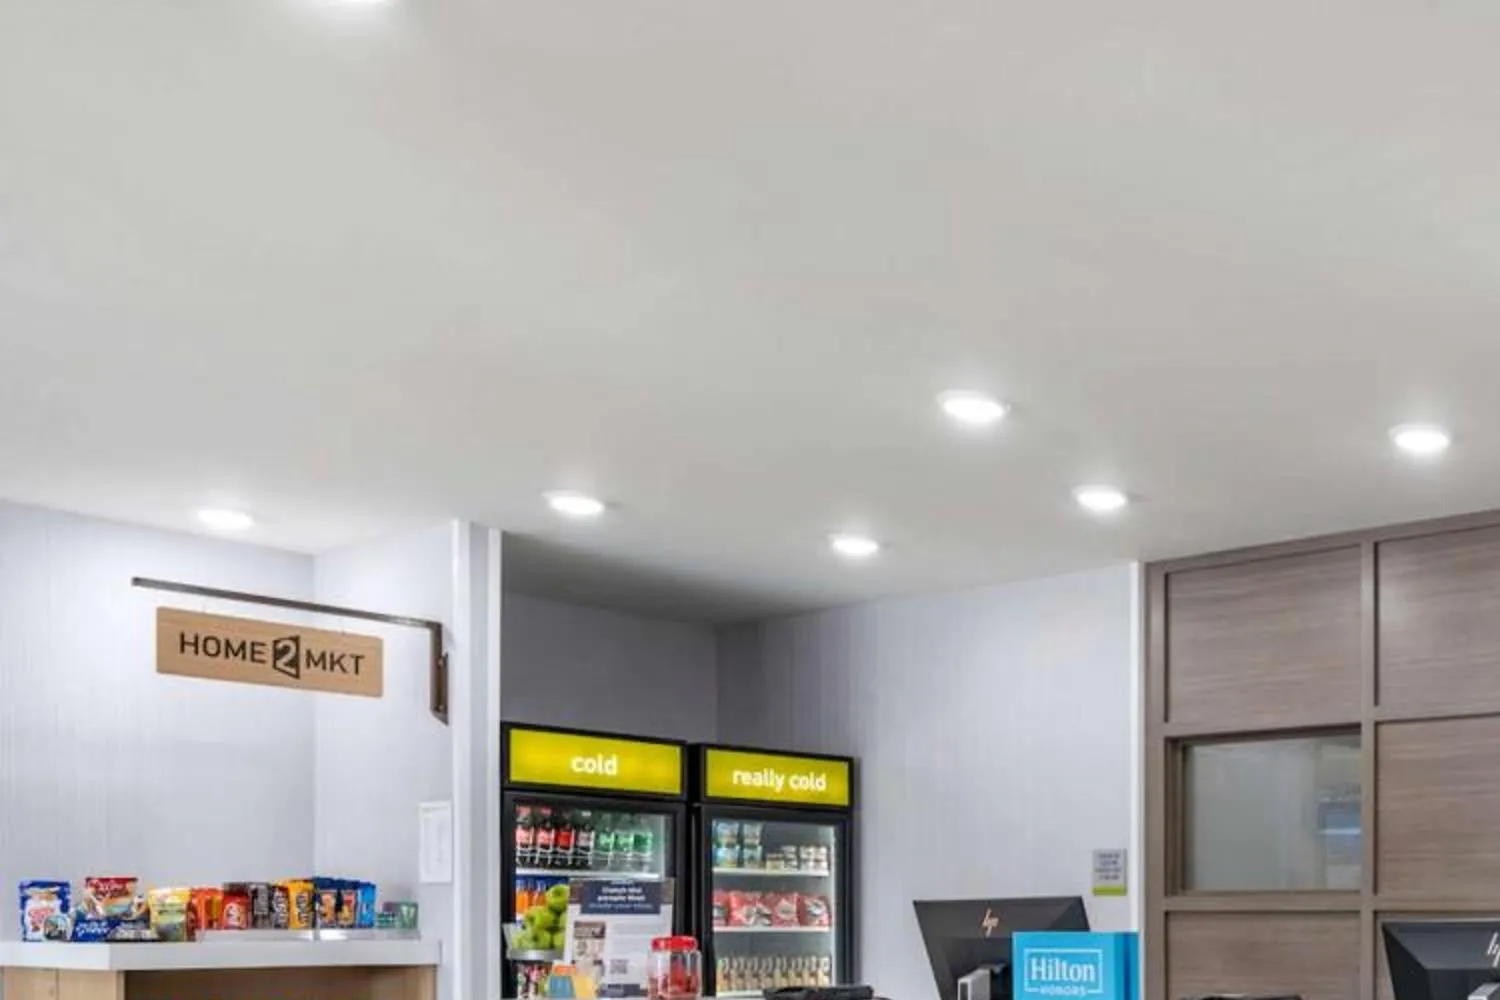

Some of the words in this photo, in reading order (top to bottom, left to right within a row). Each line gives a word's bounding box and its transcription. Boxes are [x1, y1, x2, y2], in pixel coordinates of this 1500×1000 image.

[179, 631, 267, 664] HOME
[274, 637, 299, 677] 2
[305, 649, 365, 676] MKT
[571, 753, 618, 777] cold
[732, 767, 785, 793] really
[788, 771, 827, 791] cold
[982, 907, 999, 938] hp
[1030, 957, 1097, 982] Hilton
